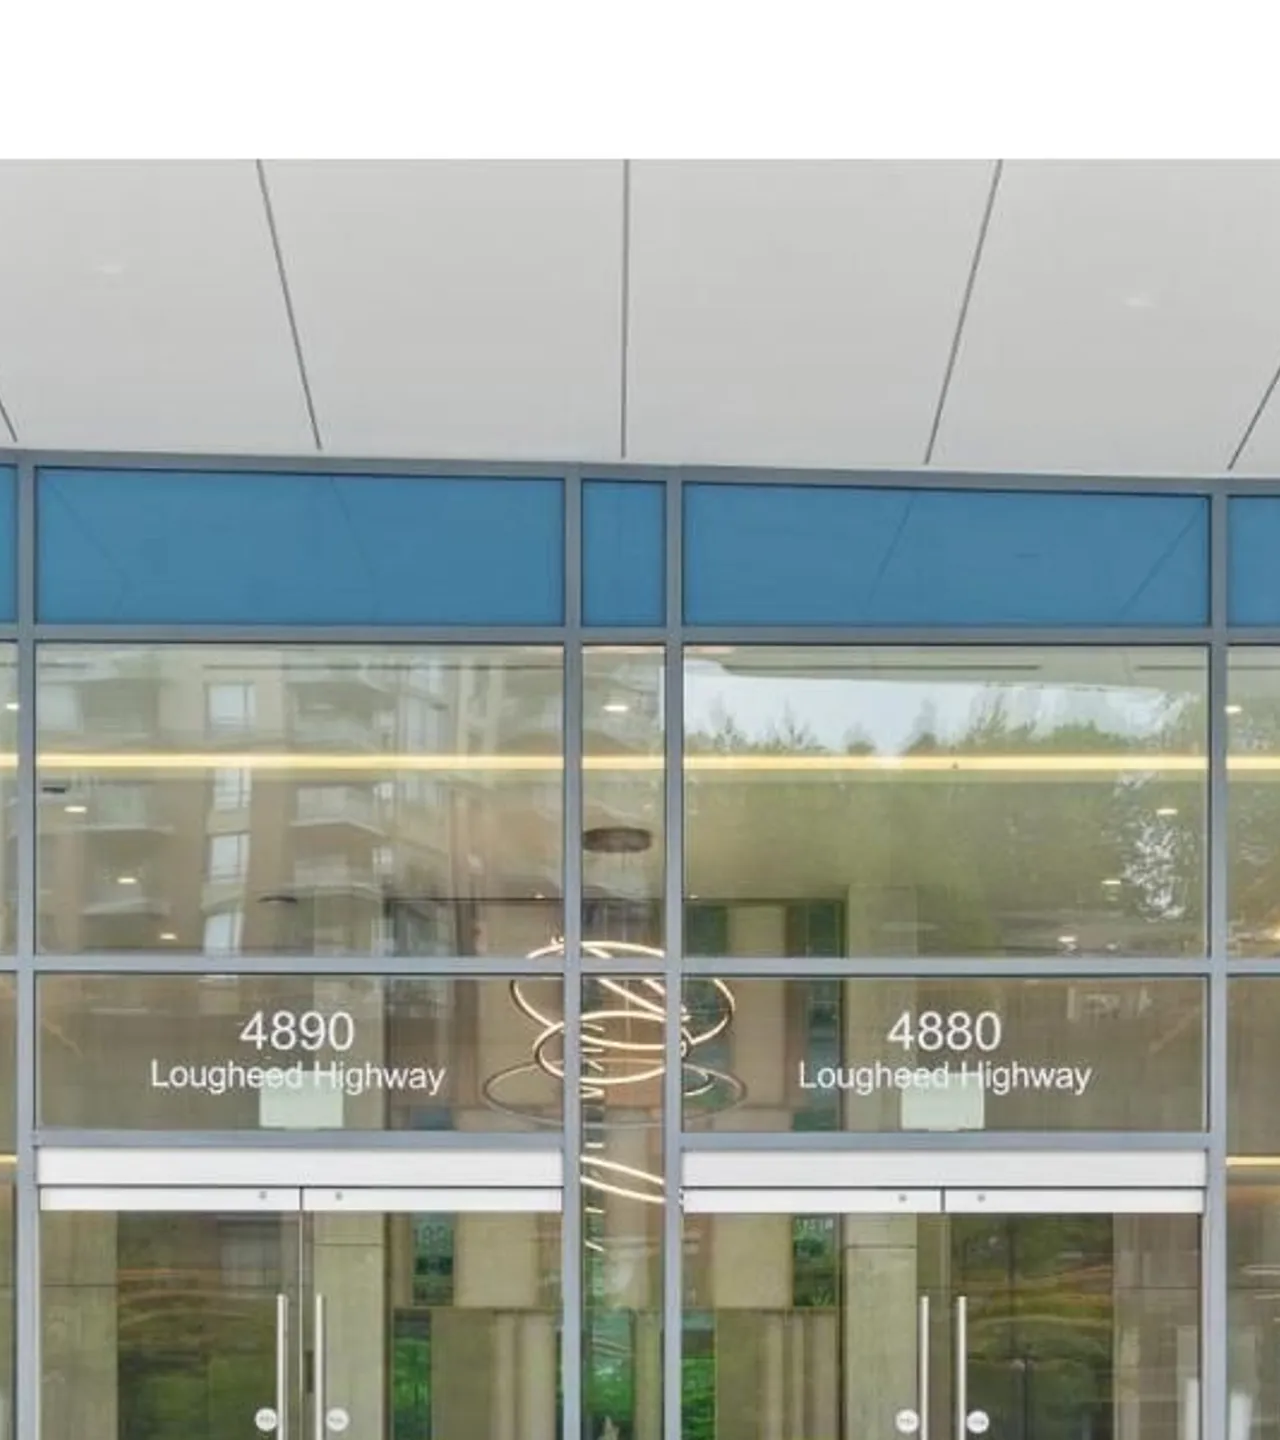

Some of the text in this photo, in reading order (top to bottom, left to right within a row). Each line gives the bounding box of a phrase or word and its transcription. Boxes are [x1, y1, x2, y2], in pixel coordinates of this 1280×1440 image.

[239, 1011, 355, 1050] 4890
[887, 1011, 1002, 1050] 4880
[151, 1059, 447, 1096] Lougheed Highway
[799, 1059, 1092, 1096] Lougheed Highway
